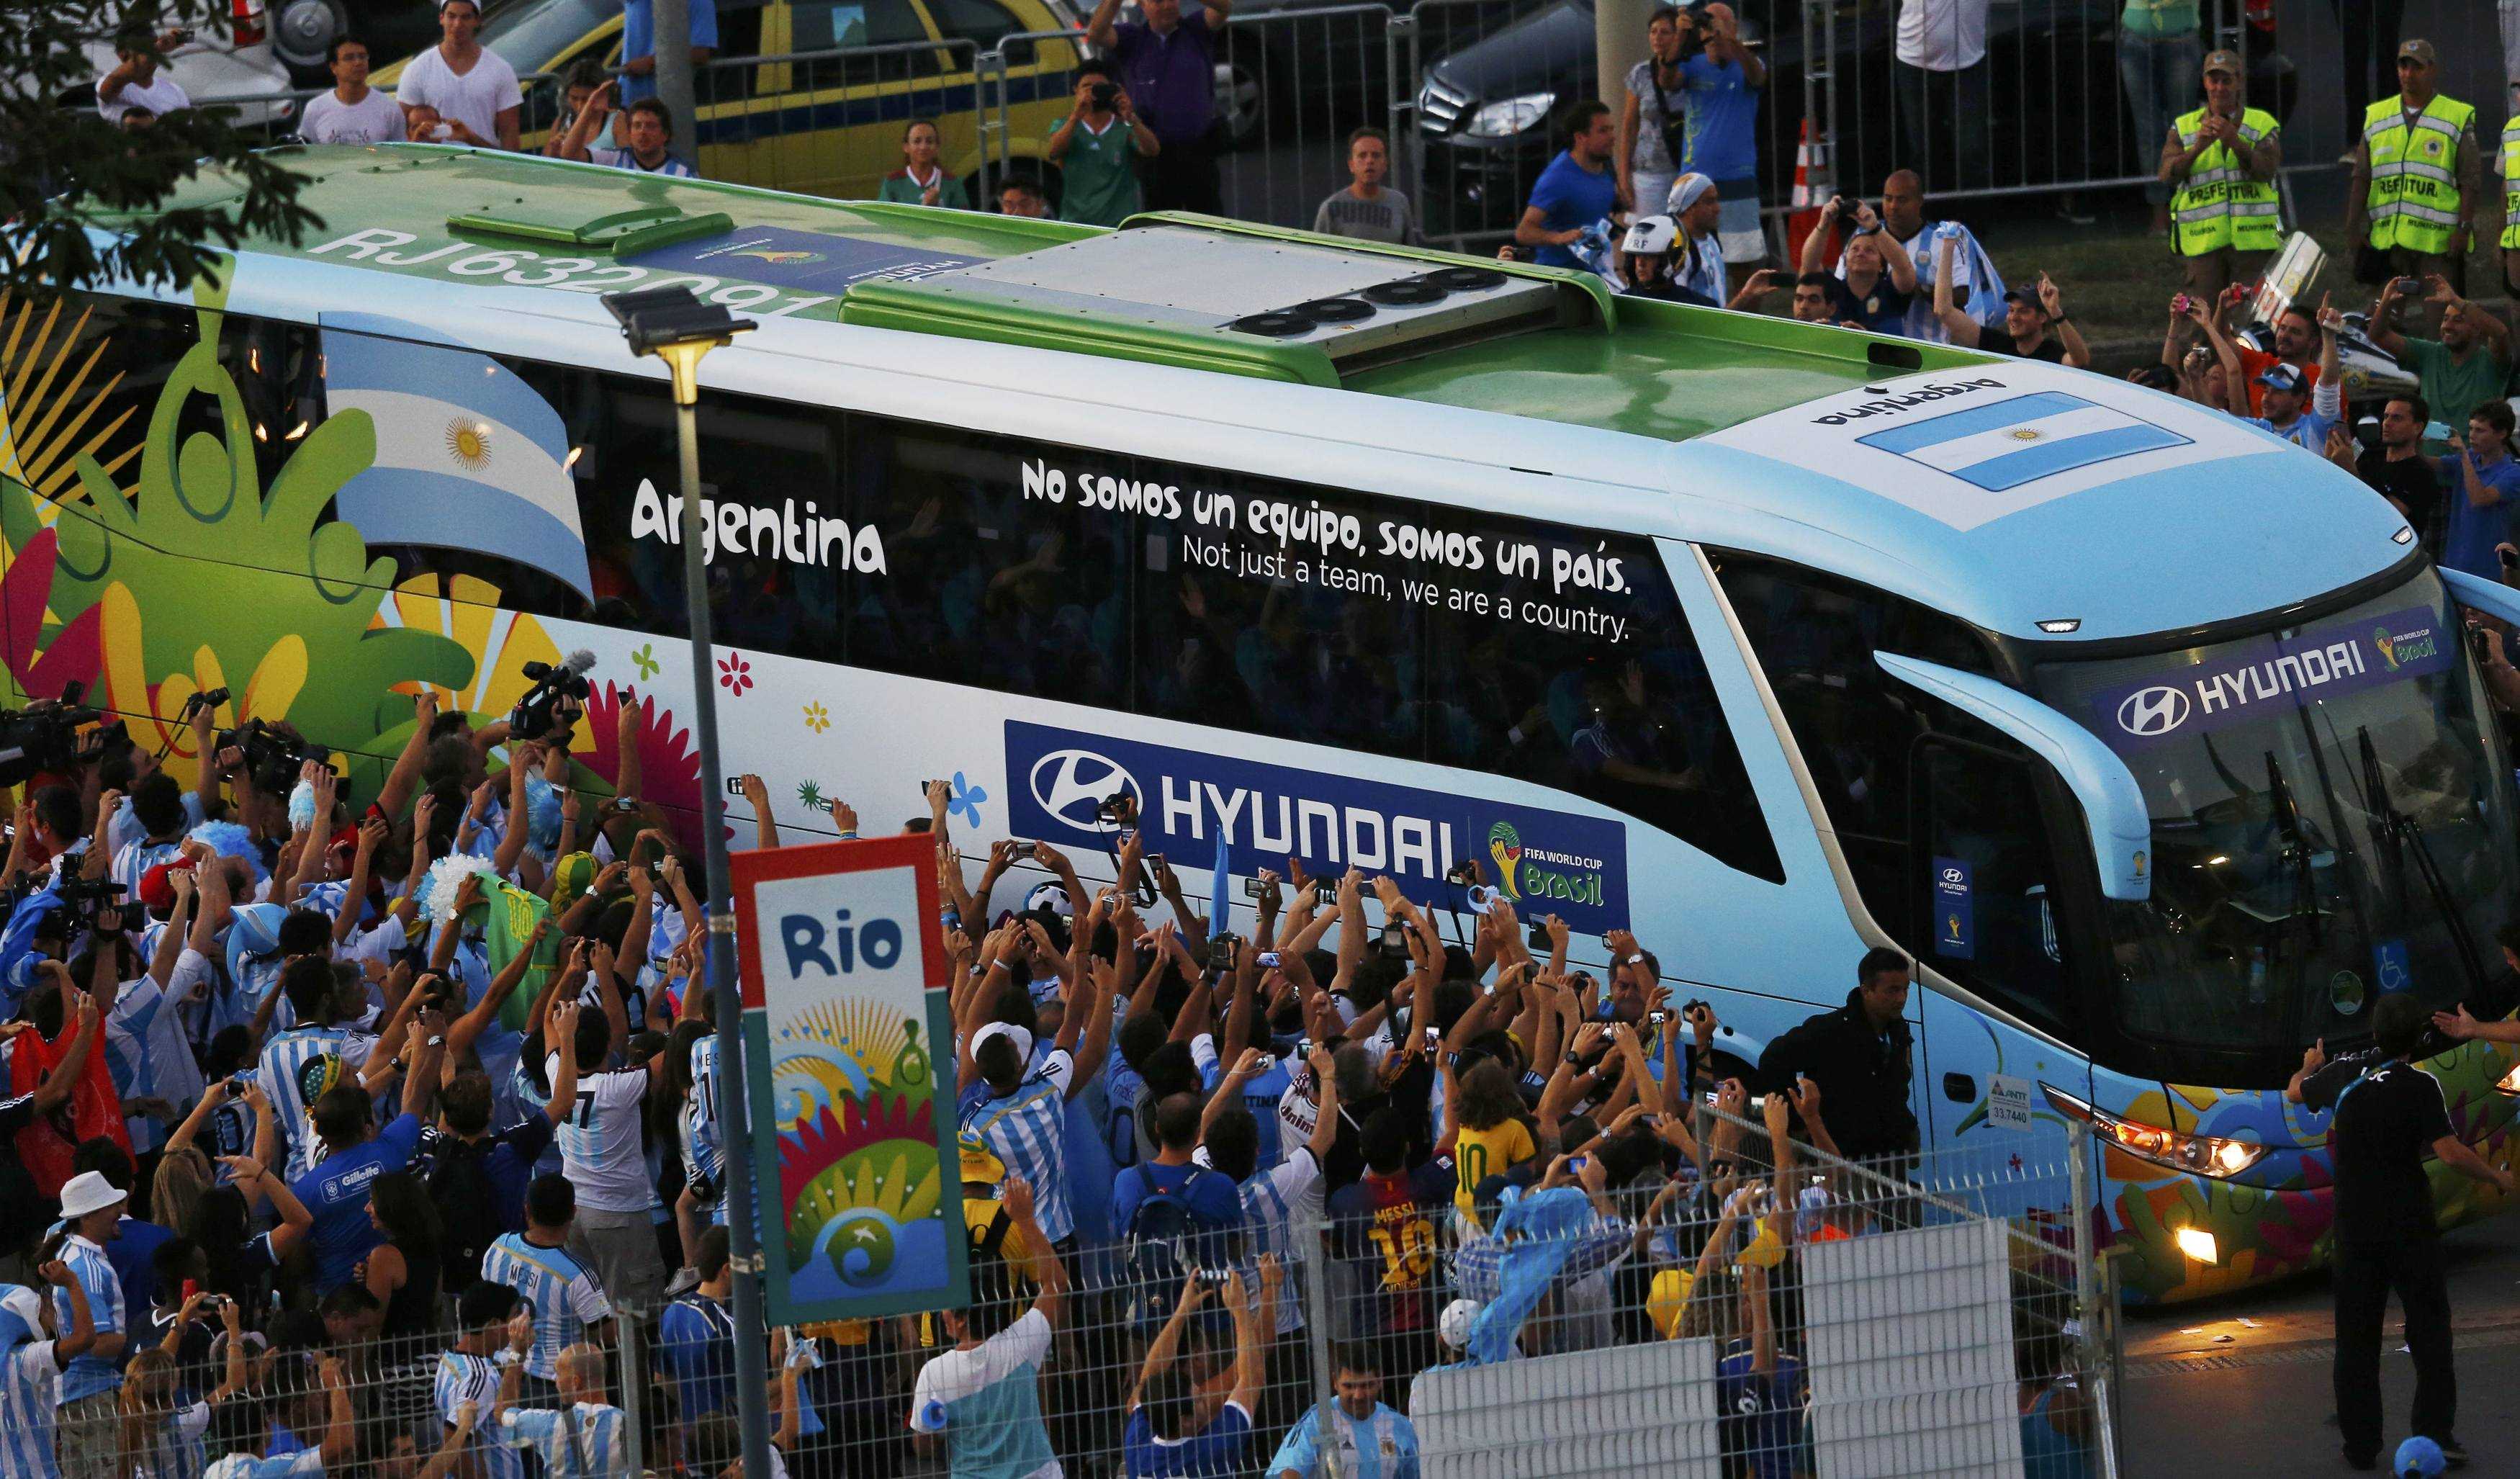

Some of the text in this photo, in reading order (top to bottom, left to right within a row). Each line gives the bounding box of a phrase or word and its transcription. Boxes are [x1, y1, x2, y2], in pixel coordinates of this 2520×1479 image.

[1810, 379, 2007, 425] Argentina
[1193, 490, 1236, 530] un
[1248, 500, 1366, 557] equipo,
[1496, 540, 1539, 580] un
[1553, 540, 1631, 595] país.
[1184, 535, 1629, 643] Not just a team, we are a country.
[2393, 634, 2405, 643] FIFA
[2403, 631, 2421, 640] WORLD
[2195, 639, 2366, 714] HYUNDAI
[1161, 776, 1453, 881] HYUNDAI
[1524, 848, 1603, 870] FIFA WORLD CUP
[1524, 863, 1603, 907] Brasil
[1939, 881, 1967, 892] HYUNDAI
[781, 909, 902, 980] Rio
[698, 1053, 719, 1068] MES
[1994, 1107, 2027, 1123] 33.7440
[342, 1166, 379, 1186] Gillette
[1459, 1143, 1487, 1194] 10
[1374, 1201, 1416, 1224] MESSI
[1368, 1220, 1436, 1284] 10
